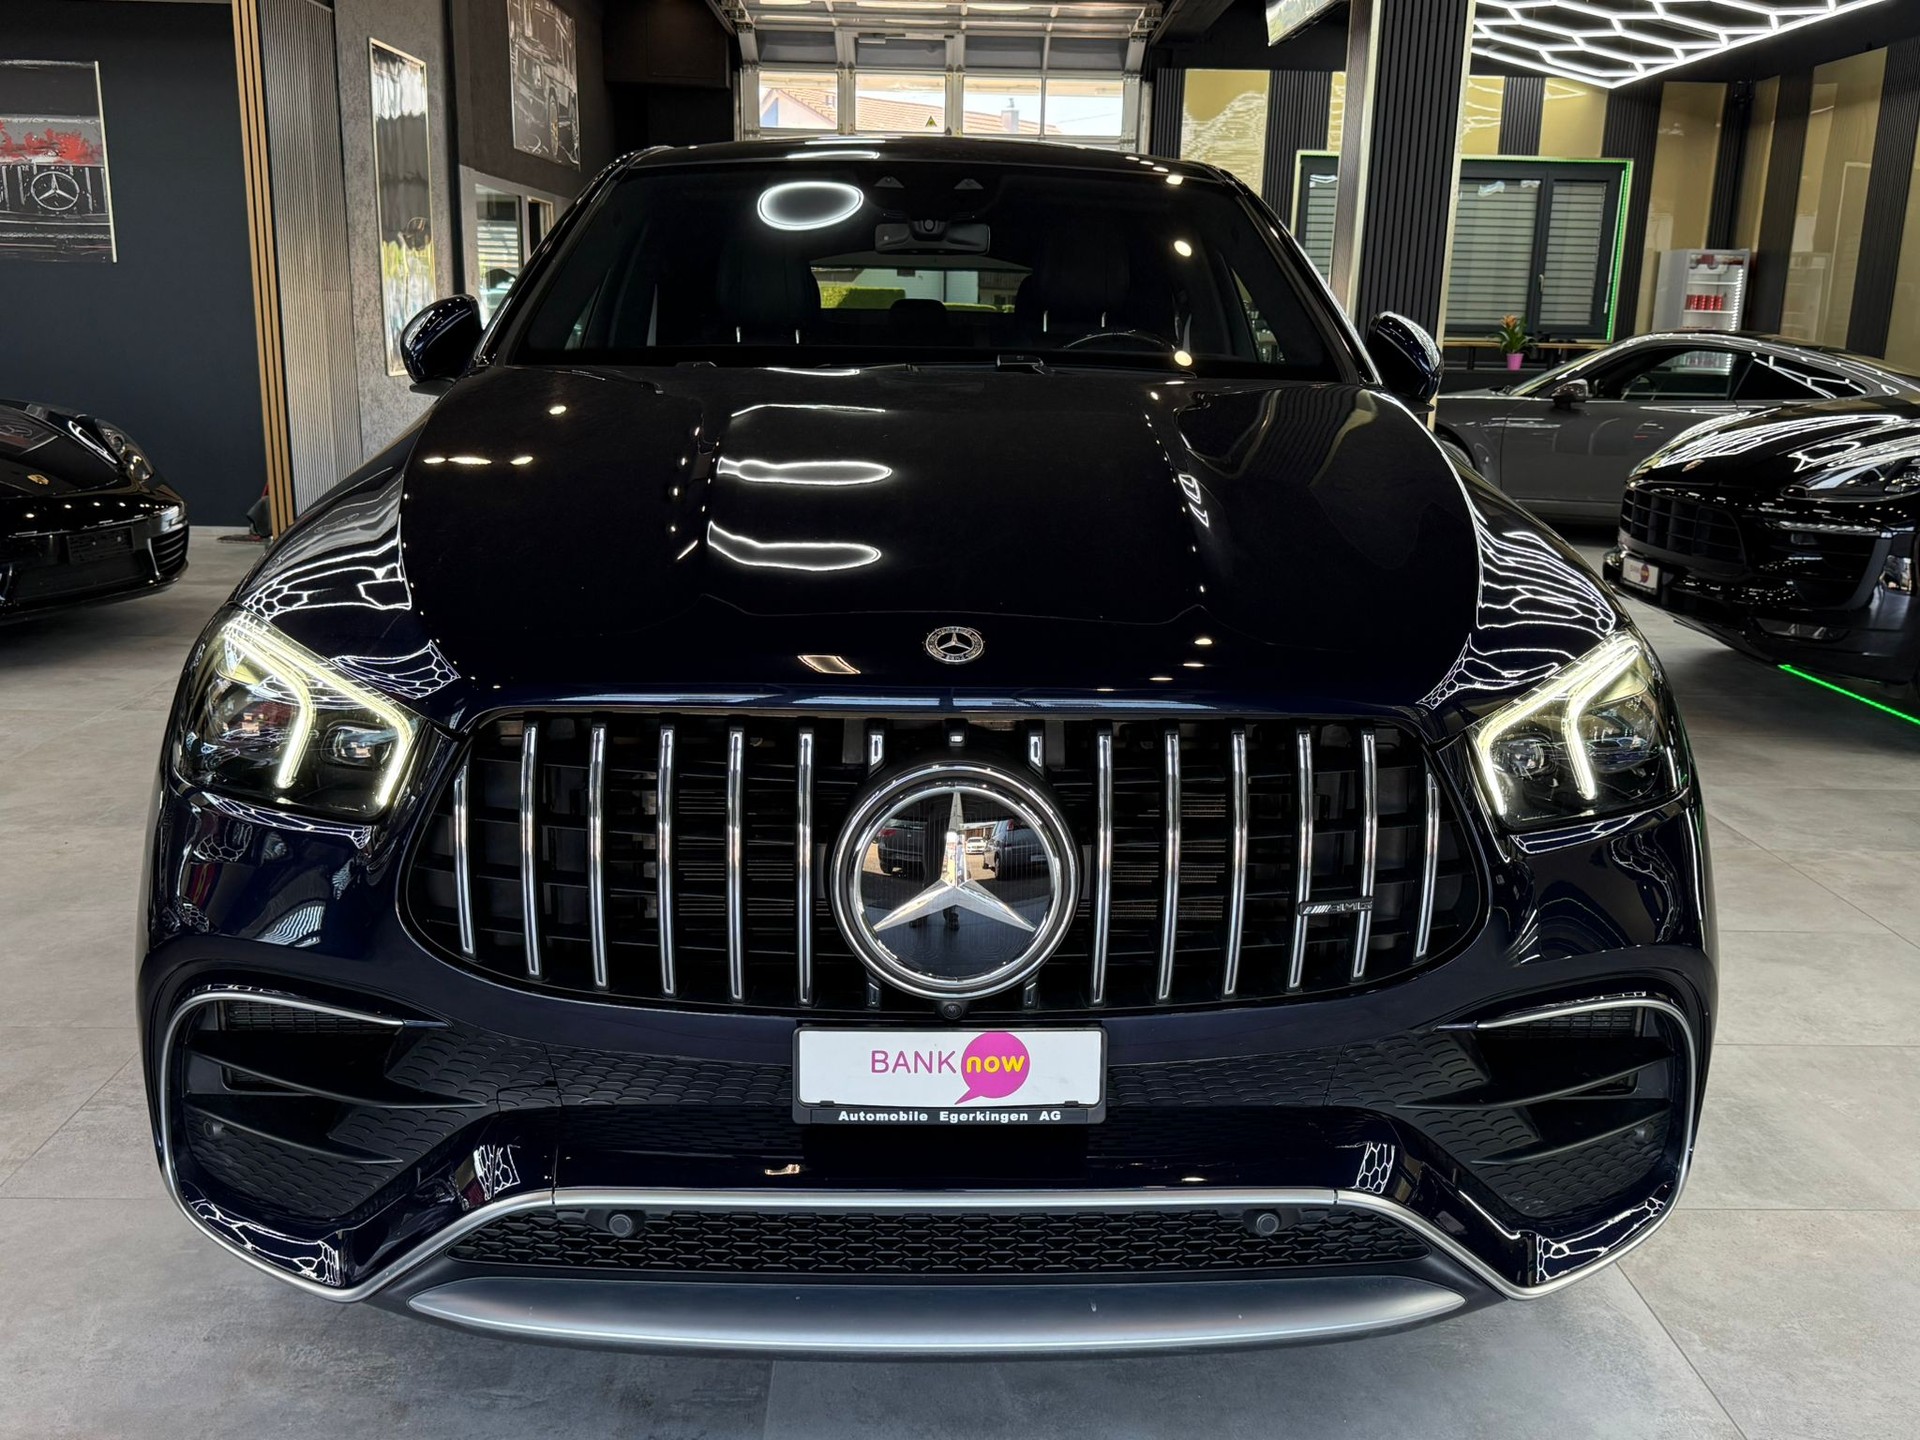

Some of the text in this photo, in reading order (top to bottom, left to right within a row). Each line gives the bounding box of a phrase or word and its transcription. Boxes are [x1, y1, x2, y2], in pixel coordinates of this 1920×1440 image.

[871, 1050, 1025, 1074] BANK now
[838, 1110, 1062, 1124] Automobile Egerkingen AG
